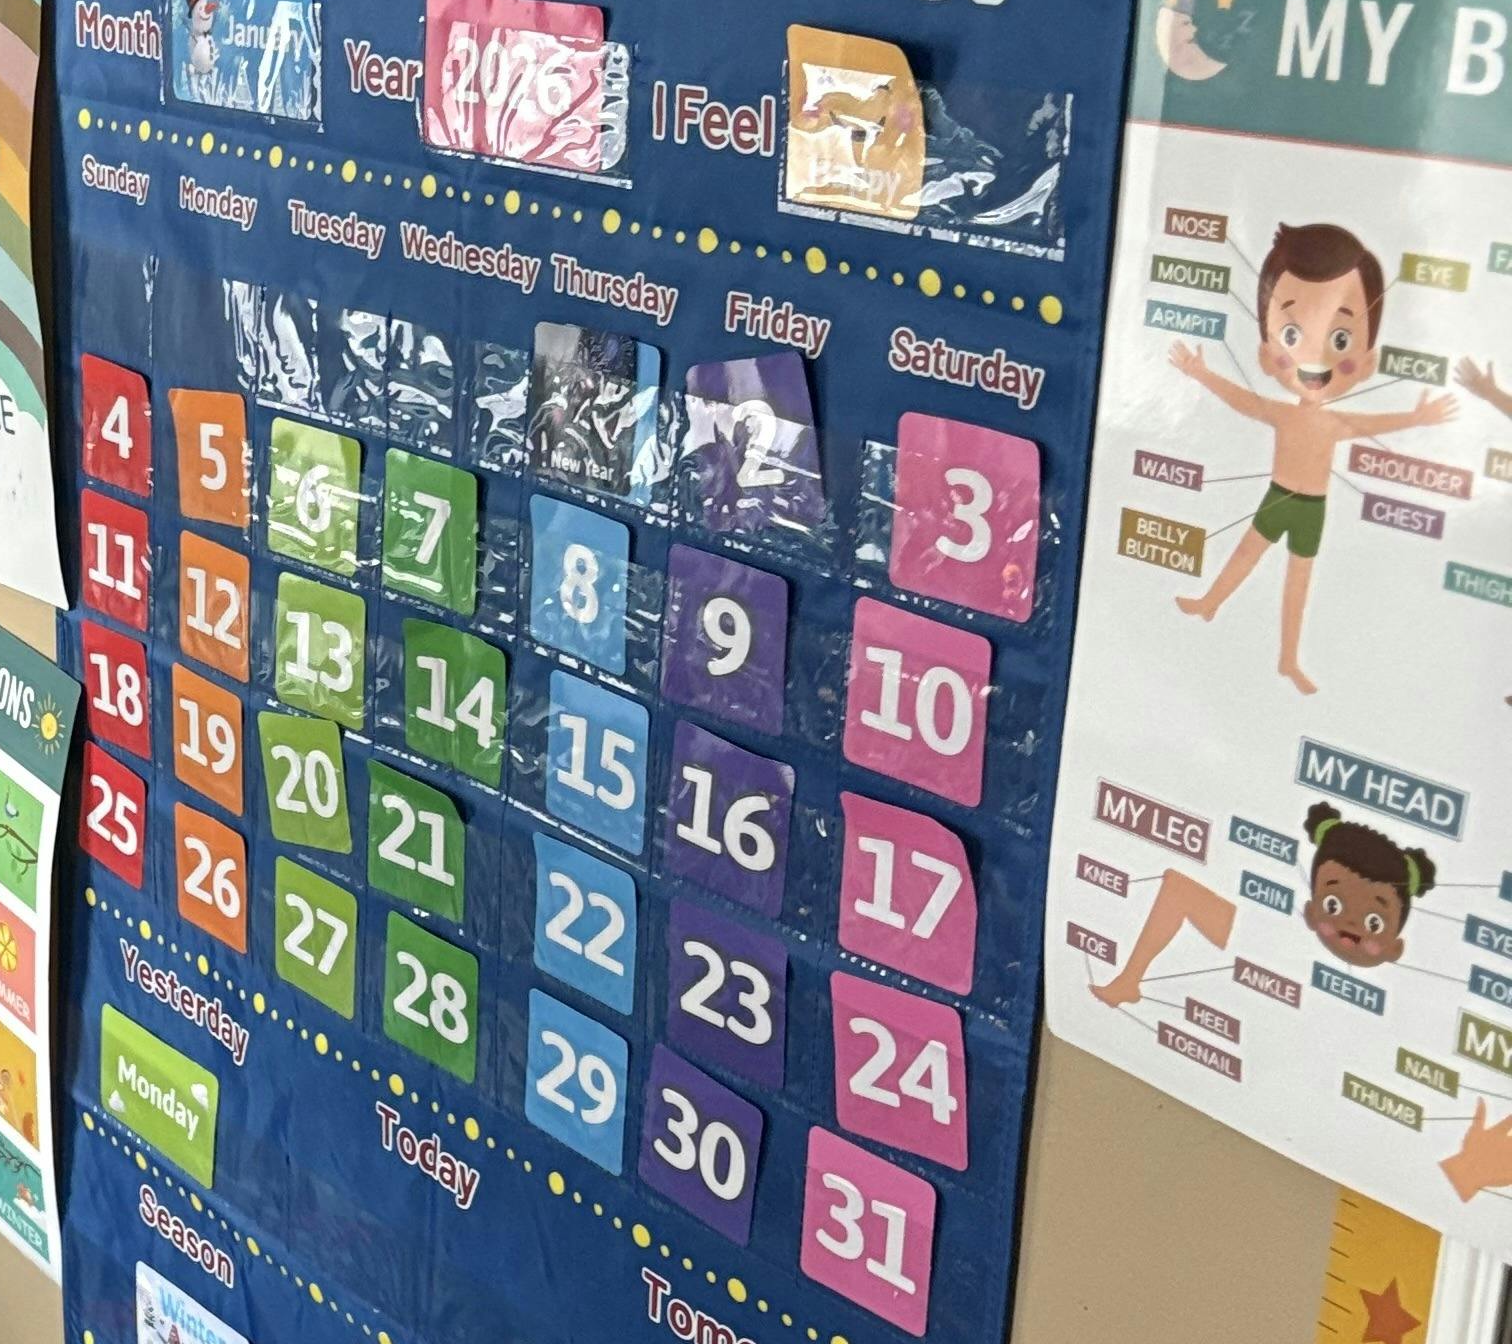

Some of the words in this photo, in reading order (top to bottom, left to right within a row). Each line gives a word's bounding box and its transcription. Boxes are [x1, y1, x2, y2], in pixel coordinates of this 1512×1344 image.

[75, 1, 163, 60] Month
[344, 38, 423, 101] Year
[653, 81, 668, 141] I
[674, 85, 776, 157] Feel
[1170, 214, 1222, 239] NOSE
[82, 153, 150, 206] Sunday
[179, 175, 257, 231] Monday
[288, 200, 386, 259] Tuesday
[400, 221, 541, 292] Wednesday
[551, 253, 679, 325] Thursday
[724, 291, 831, 360] Friday
[889, 327, 1046, 409] Saturday
[1157, 261, 1226, 290] MOUTH
[1150, 307, 1221, 337] ARMPIT
[1387, 355, 1440, 381] NECK
[1140, 457, 1198, 487] WAIST
[1357, 453, 1463, 494] SHOULDER
[934, 467, 993, 563] 3
[1135, 517, 1190, 546] BELLY
[1371, 503, 1437, 533] CHEST
[100, 395, 133, 459] 4
[199, 423, 228, 491] 5
[295, 464, 332, 532] 6
[413, 491, 451, 565] 7
[559, 542, 601, 624] 8
[702, 597, 752, 675] 9
[860, 646, 973, 756] 10
[1124, 539, 1196, 573] BUTTON
[88, 522, 141, 600] 11
[186, 567, 242, 649] 12
[285, 611, 353, 692] 13
[416, 656, 497, 749] 14
[556, 714, 636, 811] 15
[676, 765, 775, 871] 16
[854, 836, 963, 940] 17
[1306, 749, 1358, 792] MY
[1363, 769, 1455, 827] HEAD
[1102, 790, 1147, 829] MY
[1150, 808, 1203, 854] LEG
[1236, 825, 1293, 861] CHEEK
[89, 652, 143, 727] 18
[178, 696, 237, 775] 19
[270, 744, 339, 820] 20
[377, 793, 455, 887] 21
[545, 871, 625, 977] 22
[680, 940, 772, 1046] 23
[848, 1017, 958, 1126] 24
[1082, 862, 1123, 894] KNEE
[1245, 878, 1288, 910] CHIN
[1077, 930, 1108, 959] TOE
[119, 937, 250, 1066] Yesterday
[1240, 966, 1296, 1003] ANKLE
[1319, 969, 1379, 1012] TEETH
[87, 775, 139, 856] 25
[183, 836, 241, 919] 26
[284, 893, 348, 976] 27
[393, 951, 469, 1045] 28
[536, 1030, 617, 1125] 29
[653, 1087, 746, 1202] 30
[815, 1172, 916, 1296] 31
[1192, 1005, 1235, 1039] HEEL
[1164, 1029, 1236, 1077] TOENAIL
[1404, 1057, 1451, 1093] NAIL
[117, 1055, 200, 1141] Monday
[1349, 1080, 1417, 1127] THUMB
[375, 1101, 480, 1210] Today
[138, 1184, 235, 1289] Season
